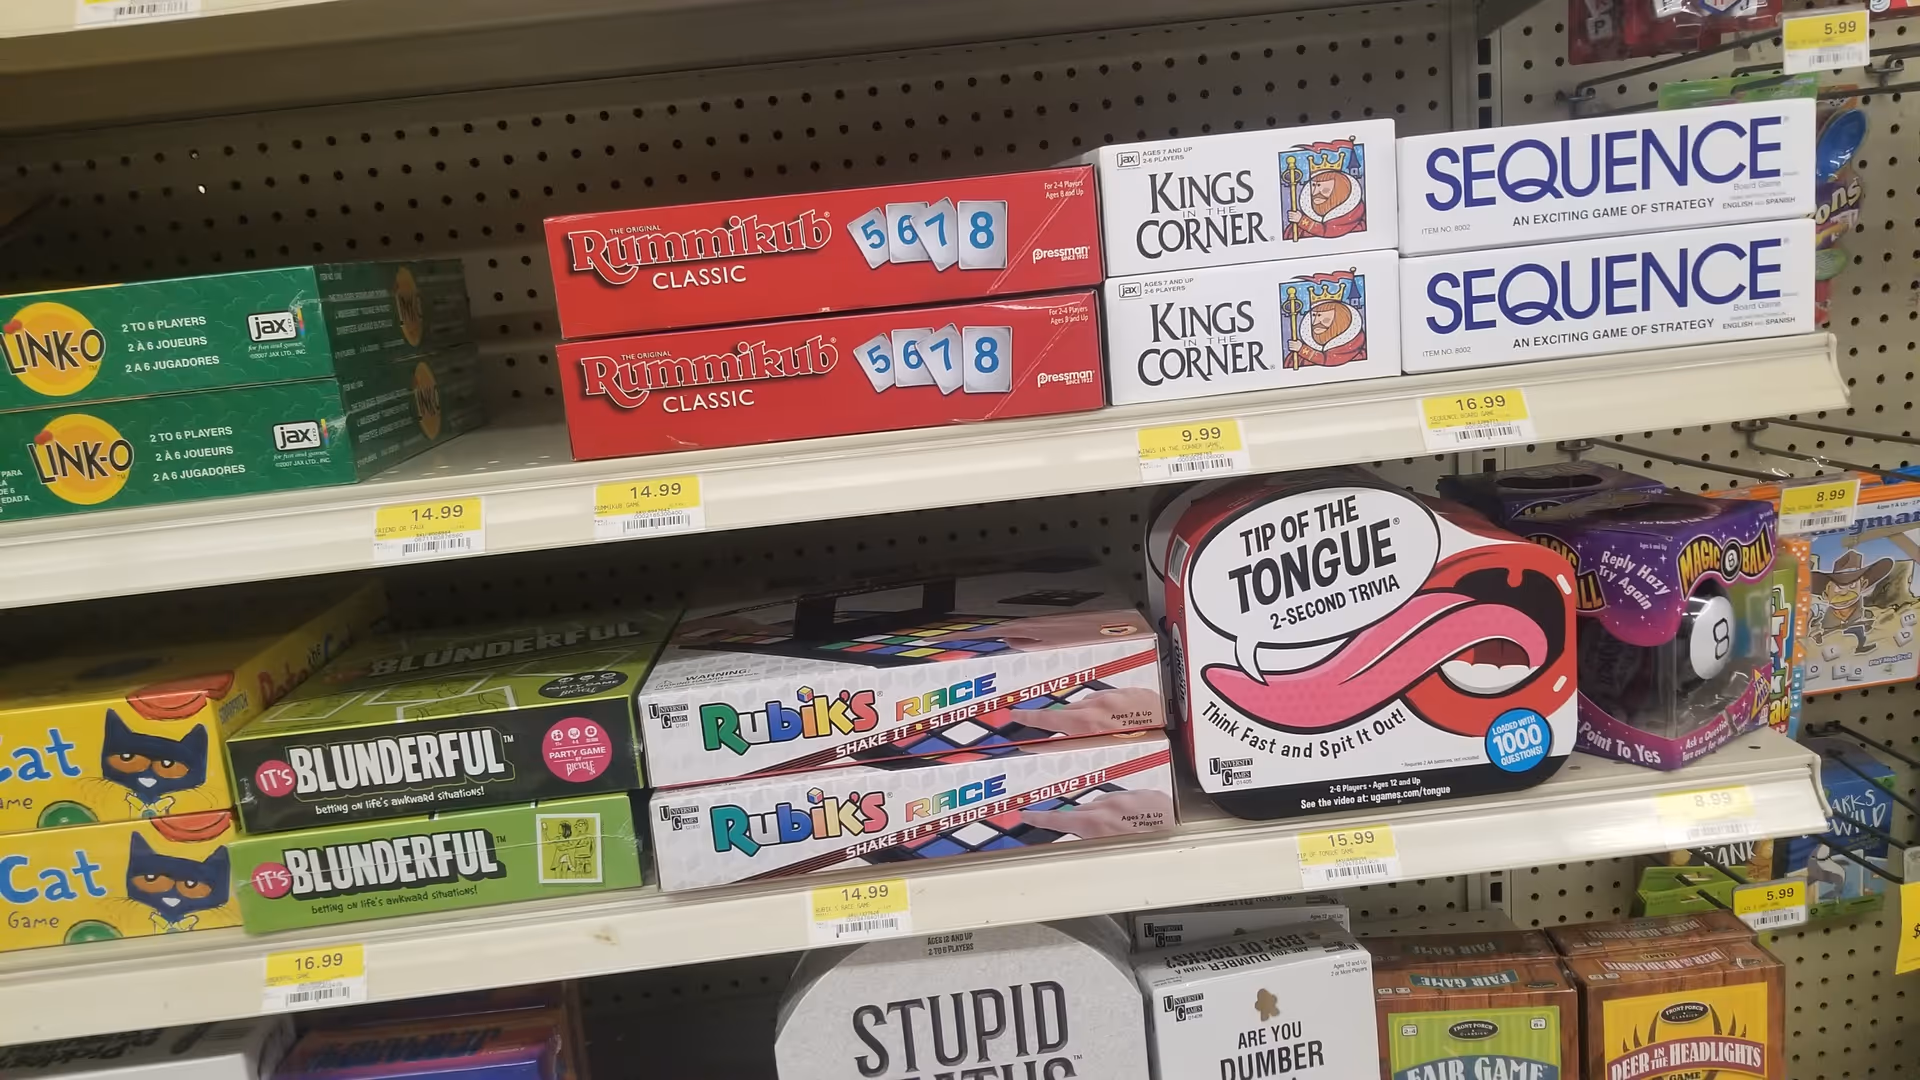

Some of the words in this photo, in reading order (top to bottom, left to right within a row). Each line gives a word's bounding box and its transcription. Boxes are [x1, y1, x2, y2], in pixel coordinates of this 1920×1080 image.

[1824, 21, 1857, 35] 5.99
[1119, 154, 1137, 166] jax
[1142, 149, 1161, 157] AGES
[1168, 147, 1183, 155] AND
[1184, 146, 1193, 154] UP
[1143, 156, 1154, 164] 2-6
[1156, 155, 1185, 163] PLAYERS
[1425, 116, 1782, 211] SEQUENCE
[1044, 182, 1054, 190] For
[1054, 181, 1063, 189] 2-4
[1148, 170, 1254, 214] KINGS
[1182, 210, 1197, 218] IN
[1207, 206, 1237, 215] THE
[1513, 214, 1531, 226] AN
[1533, 208, 1589, 225] EXCITING
[1591, 204, 1629, 220] GAME
[1631, 203, 1648, 215] OF
[1651, 198, 1715, 213] STRATEGY
[1722, 199, 1754, 209] ENGLISH
[1765, 196, 1796, 206] SPANISH
[610, 227, 625, 235] THE
[626, 224, 662, 233] ORIGINAL
[861, 219, 886, 249] 5
[897, 214, 918, 245] 6
[924, 212, 948, 247] 7
[969, 211, 995, 249] 8
[1136, 212, 1269, 259] CORNER
[1421, 227, 1439, 235] ITEM
[1454, 224, 1471, 232] 8002
[568, 209, 832, 285] Rummikub
[1032, 246, 1090, 264] pressman
[652, 265, 747, 290] CLASSIC
[1426, 238, 1782, 335] SEQUENCE
[121, 323, 129, 333] 2
[130, 321, 146, 332] TO
[148, 321, 155, 330] 6
[157, 316, 207, 329] PLAYERS
[254, 317, 287, 340] jax
[1150, 301, 1255, 343] KINGS
[155, 336, 208, 349] JOUEURS
[1513, 337, 1531, 349] AN
[1533, 331, 1589, 348] EXCITING
[1591, 327, 1629, 343] GAME
[1631, 325, 1648, 338] OF
[1651, 318, 1715, 336] STRATEGY
[0, 328, 106, 375] LINK-O
[621, 353, 636, 361] THE
[637, 350, 672, 359] ORIGINAL
[125, 363, 132, 373] 2
[134, 363, 143, 372] A
[144, 362, 151, 371] 6
[152, 355, 220, 370] JUGADORES
[581, 335, 839, 408] Rummikub
[1137, 341, 1269, 386] CORNER
[1037, 370, 1094, 388] pressman
[662, 389, 755, 413] CLASSIC
[1455, 395, 1506, 411] 16.99
[184, 426, 233, 439] PLAYERS
[280, 424, 312, 448] jax
[1182, 428, 1221, 442] 9.99
[27, 439, 134, 484] LINK-O
[630, 483, 682, 499] 14.99
[1816, 489, 1846, 502] 8.99
[411, 505, 464, 522] 14.99
[1240, 522, 1275, 557] TIP
[1281, 510, 1309, 543] OF
[1314, 495, 1360, 532] THE
[1228, 518, 1397, 614] TONGUE
[1601, 550, 1635, 577] Reply
[1636, 563, 1671, 597] Hazy
[1679, 538, 1721, 599] MAGIC
[1741, 531, 1772, 576] BALL
[1599, 565, 1616, 582] Try
[1618, 574, 1652, 610] Again
[1269, 592, 1347, 630] 2-SECOND
[1349, 574, 1400, 604] TRIVIA
[370, 622, 641, 676] BLUNDERFUL
[1712, 617, 1730, 661] 8
[896, 673, 997, 722] RACE
[836, 731, 888, 758] SHAKE
[891, 725, 910, 741] IT
[929, 704, 978, 729] SLIDE
[983, 698, 1001, 713] IT
[1019, 677, 1069, 703] SOLVE
[1074, 668, 1096, 685] IT!
[1111, 713, 1128, 721] Ages
[1128, 717, 1153, 727] Players
[1201, 701, 1238, 738] Think
[1240, 727, 1276, 753] Fast
[1281, 742, 1313, 759] and
[1319, 735, 1356, 760] Spit
[1357, 727, 1373, 748] It
[1372, 708, 1407, 737] Out!
[1492, 720, 1518, 736] LOADED
[1518, 714, 1536, 729] WITH
[1492, 723, 1543, 754] 1000
[1579, 721, 1612, 753] Point
[1615, 738, 1632, 758] To
[1634, 743, 1661, 765] Yes
[259, 768, 294, 791] IT'S
[288, 729, 505, 794] BLUNDERFUL
[549, 750, 577, 759] PARTY
[580, 747, 606, 756] GAME
[1500, 745, 1543, 766] QUESTIONS!
[566, 760, 596, 777] BICYCLE
[1342, 783, 1367, 793] Players
[1372, 781, 1389, 790] Ages
[1390, 779, 1397, 787] 12
[1398, 778, 1411, 786] and
[1412, 777, 1421, 786] Up
[365, 799, 389, 809] life's
[906, 774, 1007, 823] RACE
[1301, 799, 1316, 809] See
[1318, 797, 1332, 807] the
[1334, 795, 1355, 806] video
[1357, 794, 1369, 803] at:
[1370, 786, 1451, 802] ugames.com/tongue
[1695, 792, 1732, 808] 8.99
[1328, 831, 1375, 848] 15.99
[256, 869, 290, 892] IT'S
[284, 830, 497, 895] BLUNDERFUL
[0, 850, 107, 904] Cat
[841, 885, 889, 902] 14.99
[1766, 888, 1795, 901] 5.99
[8, 913, 59, 929] Game
[928, 936, 943, 945] AGES
[951, 934, 964, 942] AND
[964, 932, 973, 941] UP
[294, 953, 344, 971] 16.99
[852, 980, 1069, 1079] STUPID
[1238, 1028, 1267, 1050] ARE
[1271, 1021, 1302, 1042] YOU
[1220, 1040, 1325, 1080] DUMBER
[1651, 1057, 1668, 1070] THE
[1654, 1047, 1664, 1058] IN
[1670, 1041, 1761, 1068] HEADLIGHTS
[1611, 1053, 1649, 1080] DEER
